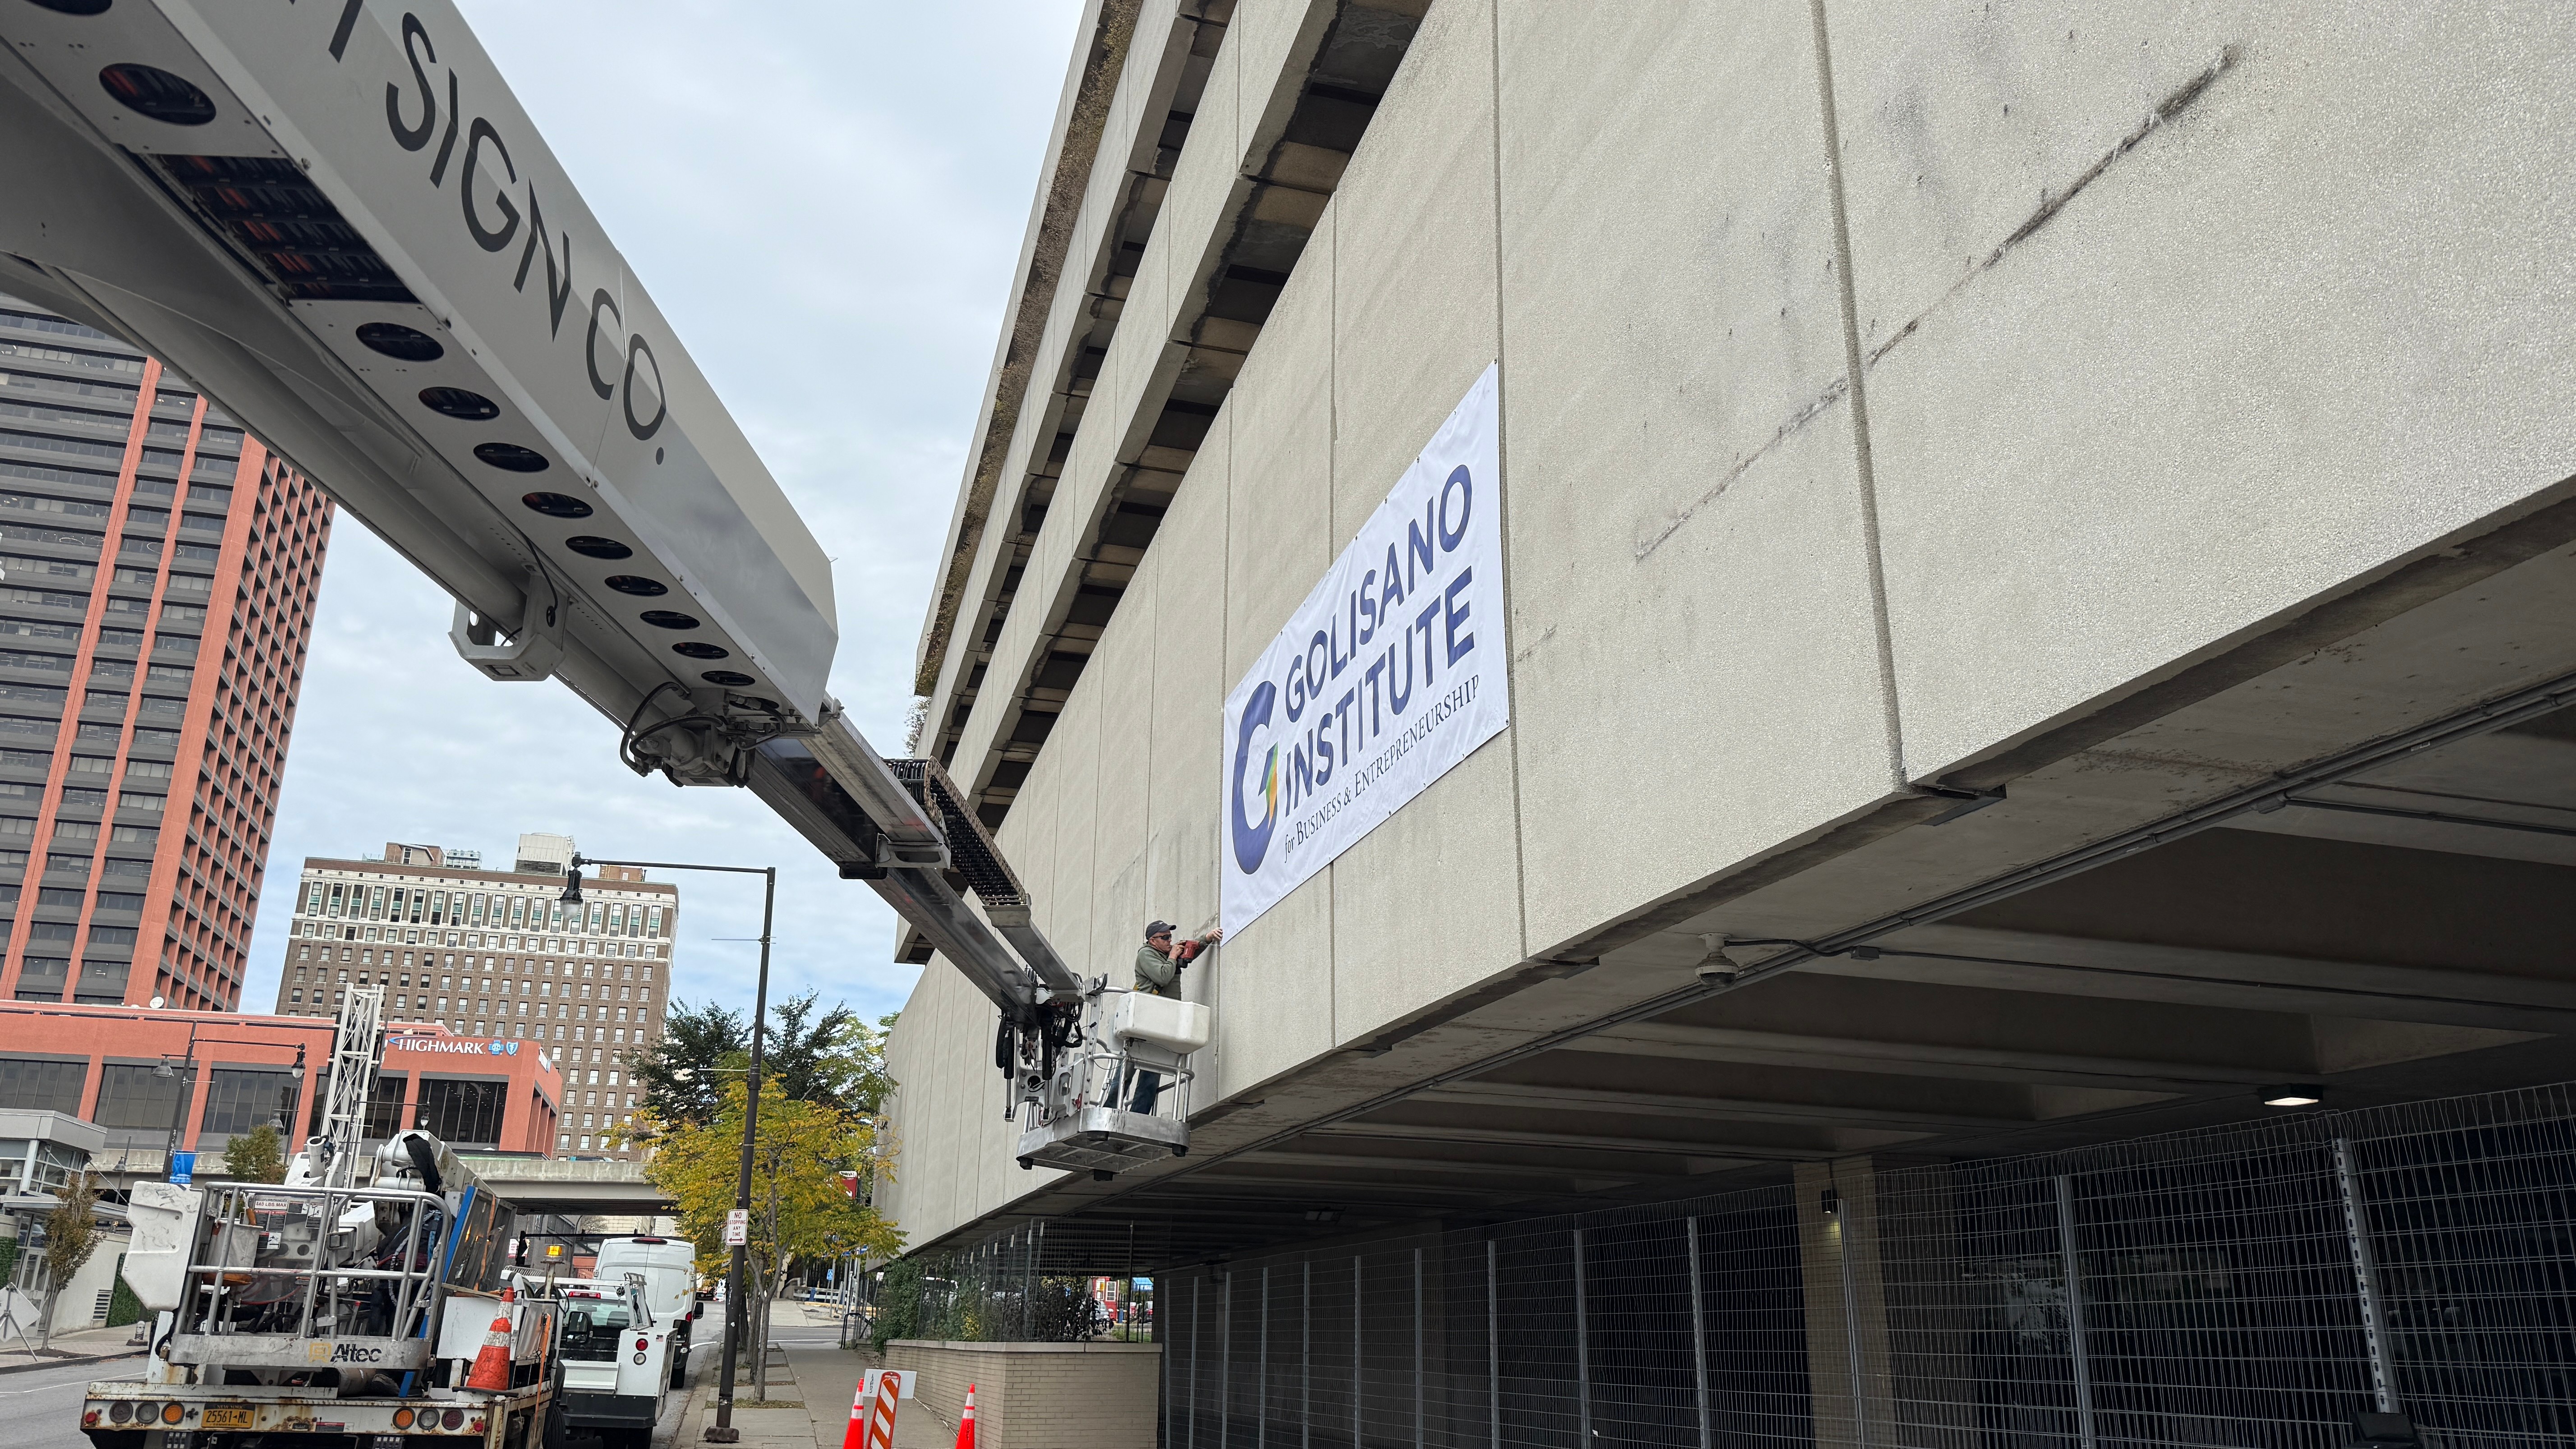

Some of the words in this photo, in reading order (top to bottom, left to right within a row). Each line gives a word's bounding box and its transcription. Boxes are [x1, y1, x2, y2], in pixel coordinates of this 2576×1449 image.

[386, 12, 572, 343] SIGN
[1285, 464, 1472, 725] GOLISANO
[1285, 565, 1475, 818] INSTITUTE
[1285, 834, 1295, 863] for
[1343, 787, 1352, 806] &
[398, 1038, 484, 1054] HIGHMARK
[330, 1343, 382, 1362] Altec
